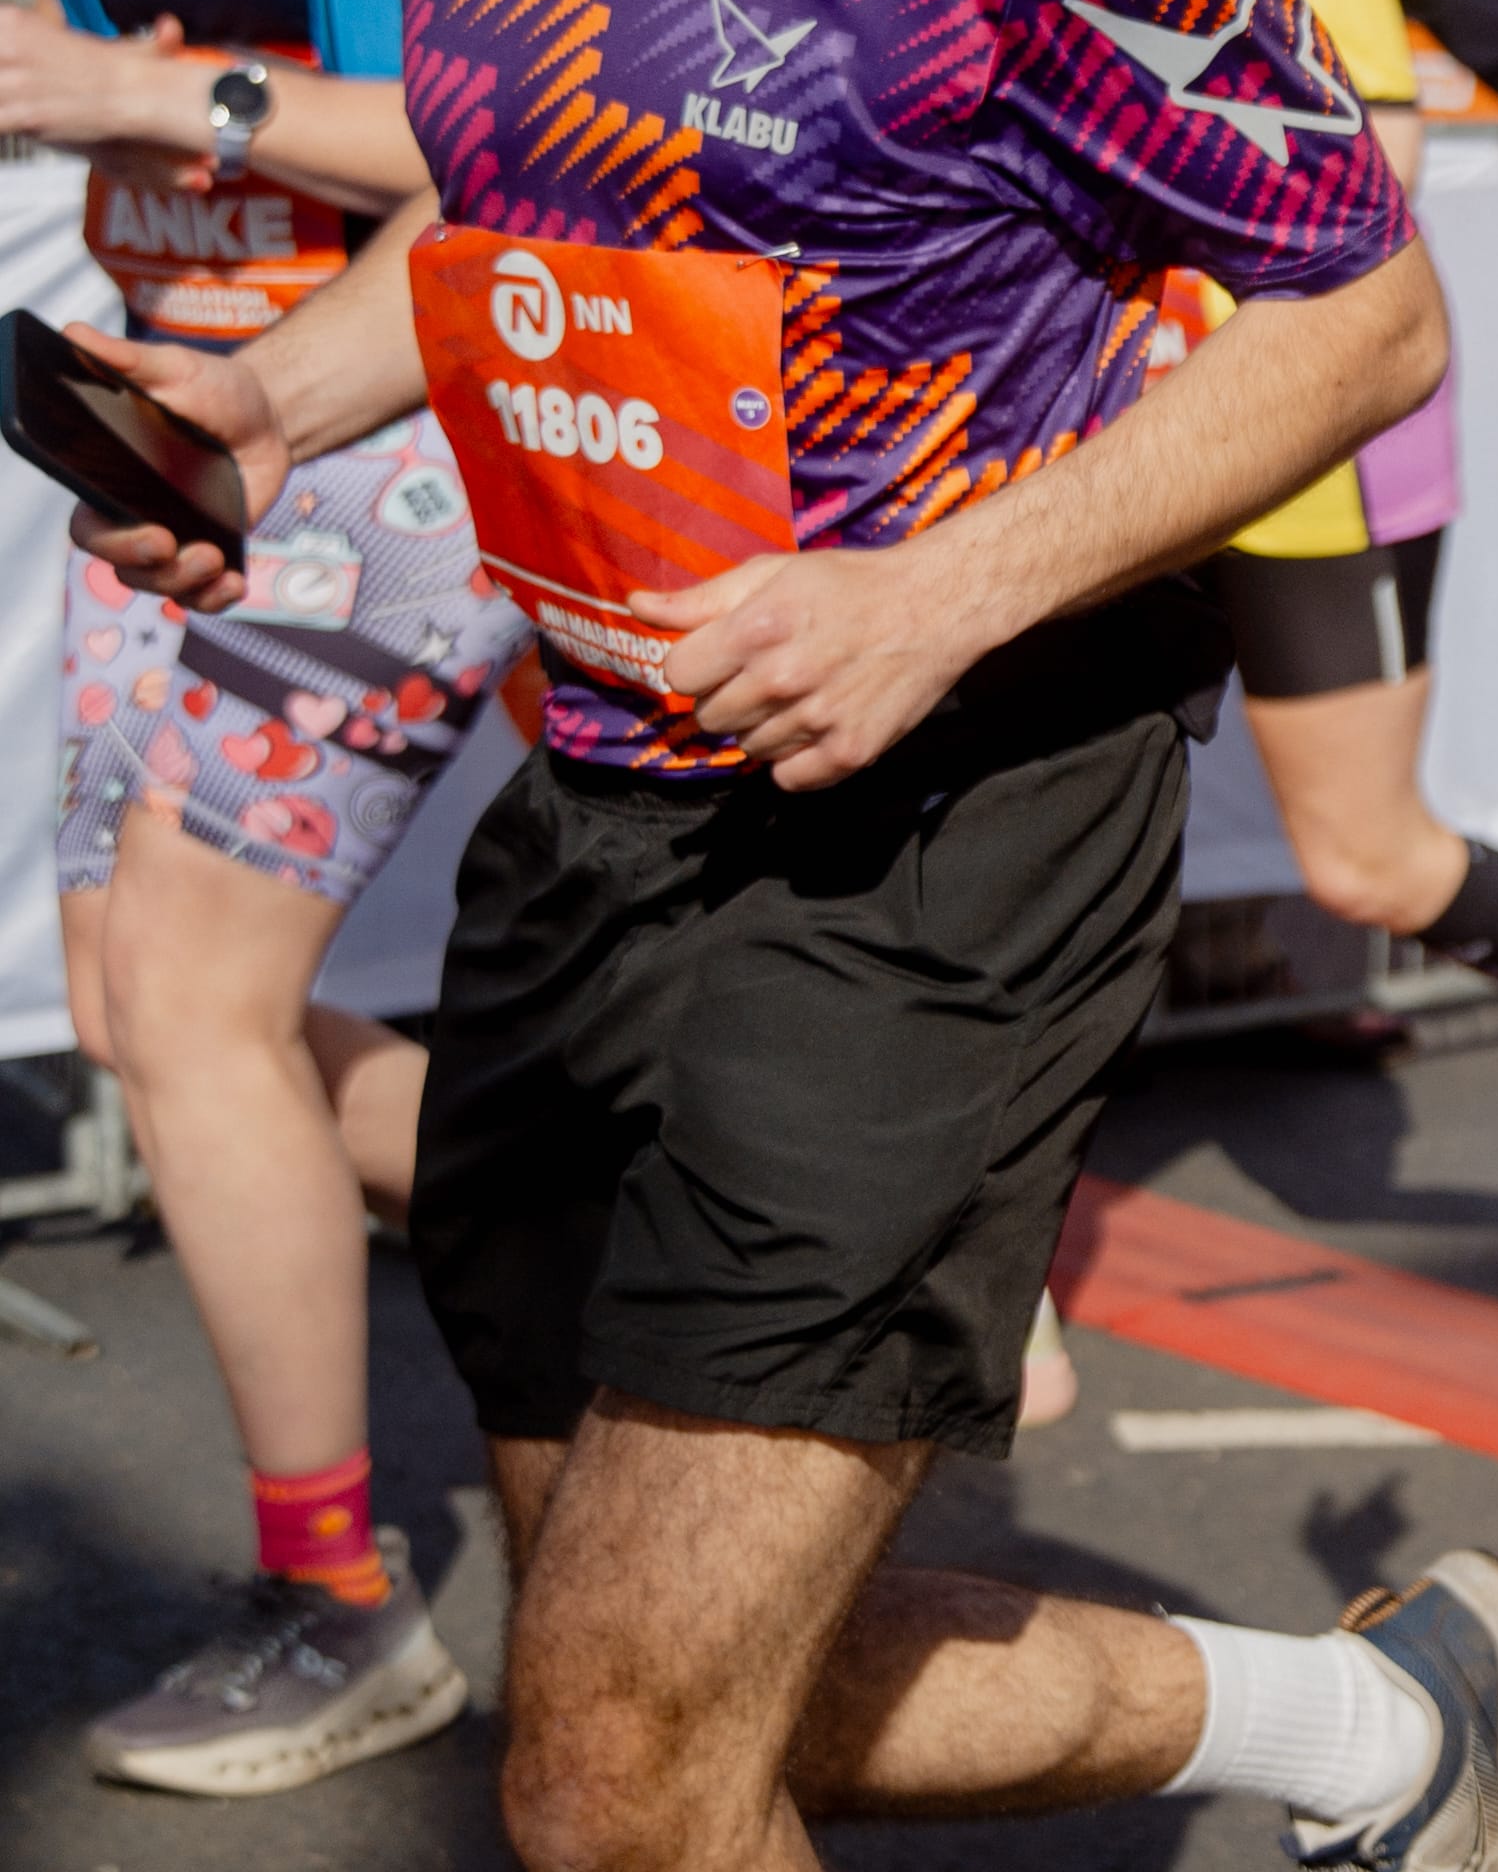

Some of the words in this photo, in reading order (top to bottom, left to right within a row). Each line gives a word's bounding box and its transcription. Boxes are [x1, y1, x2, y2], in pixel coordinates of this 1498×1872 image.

[682, 93, 799, 155] KLABU
[105, 189, 298, 260] ANKE
[572, 292, 634, 336] NN
[487, 380, 664, 471] 11806
